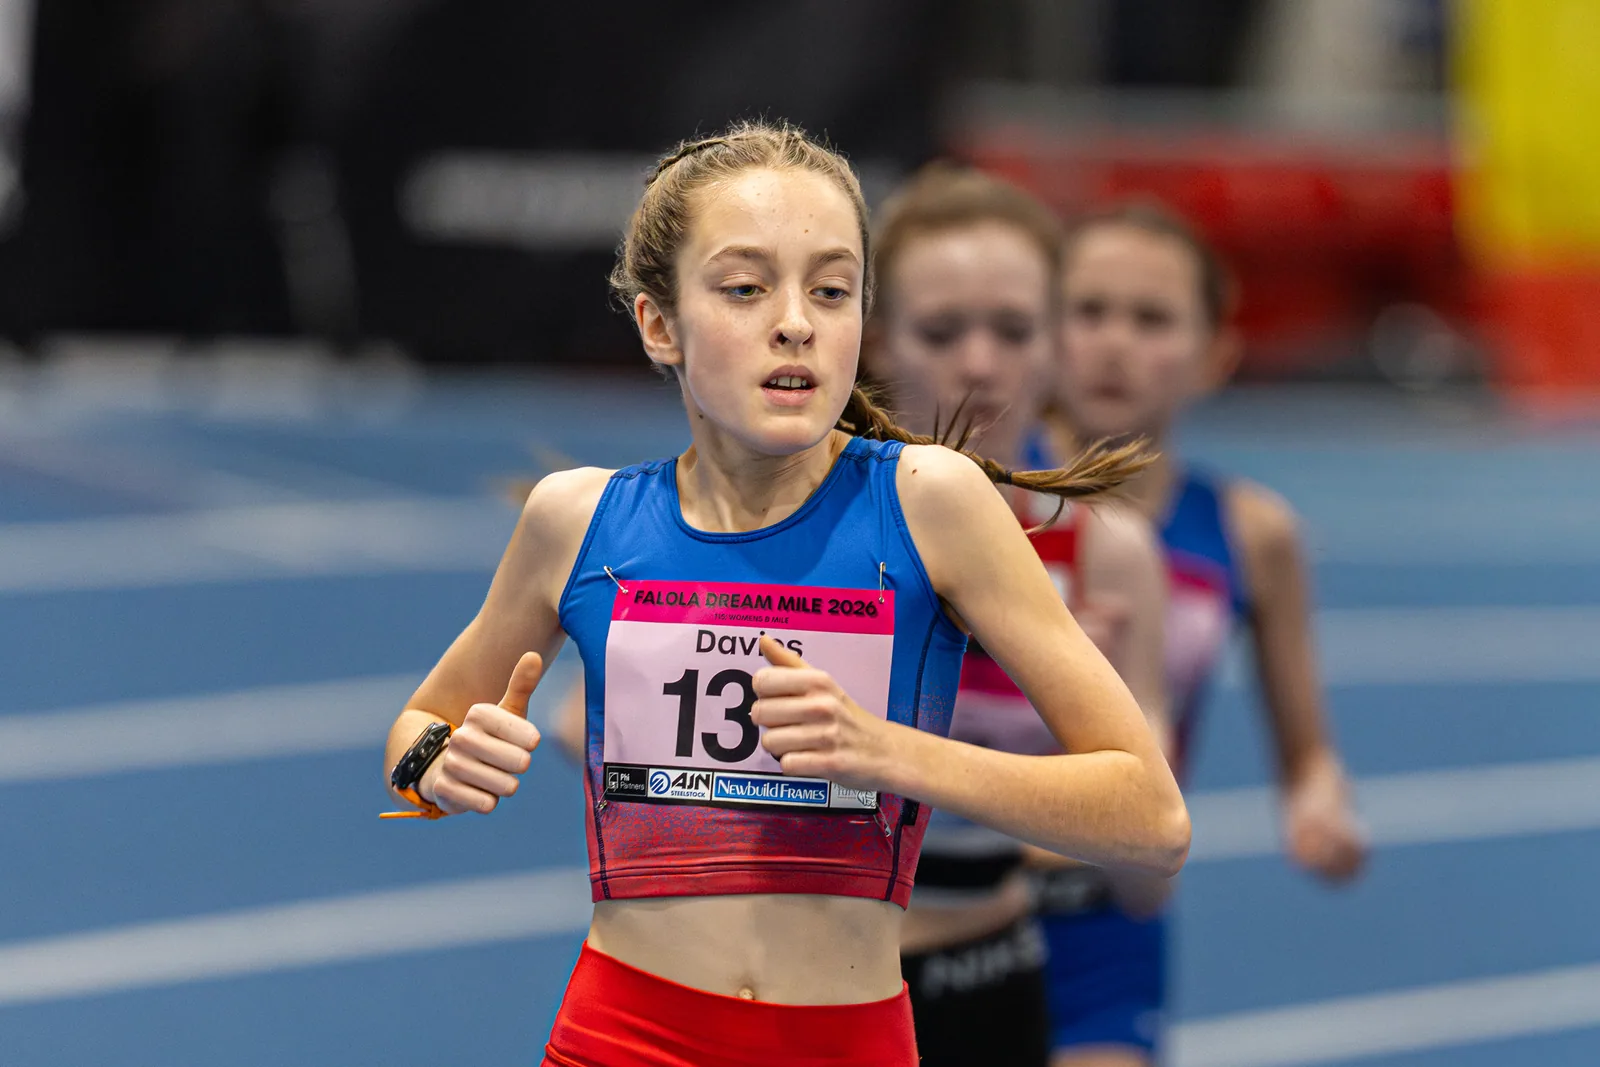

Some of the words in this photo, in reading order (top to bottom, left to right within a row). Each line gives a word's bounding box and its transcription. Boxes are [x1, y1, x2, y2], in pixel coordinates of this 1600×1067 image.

[633, 590, 700, 606] FALOLA
[705, 592, 773, 610] DREAM
[778, 595, 823, 614] MILE
[828, 598, 879, 618] 2026
[729, 613, 763, 622] WOMENS
[771, 616, 790, 624] MILE
[696, 629, 803, 658] Davs
[663, 668, 782, 763] 13
[620, 773, 630, 781] Phi
[671, 772, 711, 791] AJN
[620, 782, 645, 790] Partners
[670, 790, 706, 798] STEELSTOCK
[780, 783, 825, 800] FRAMES
